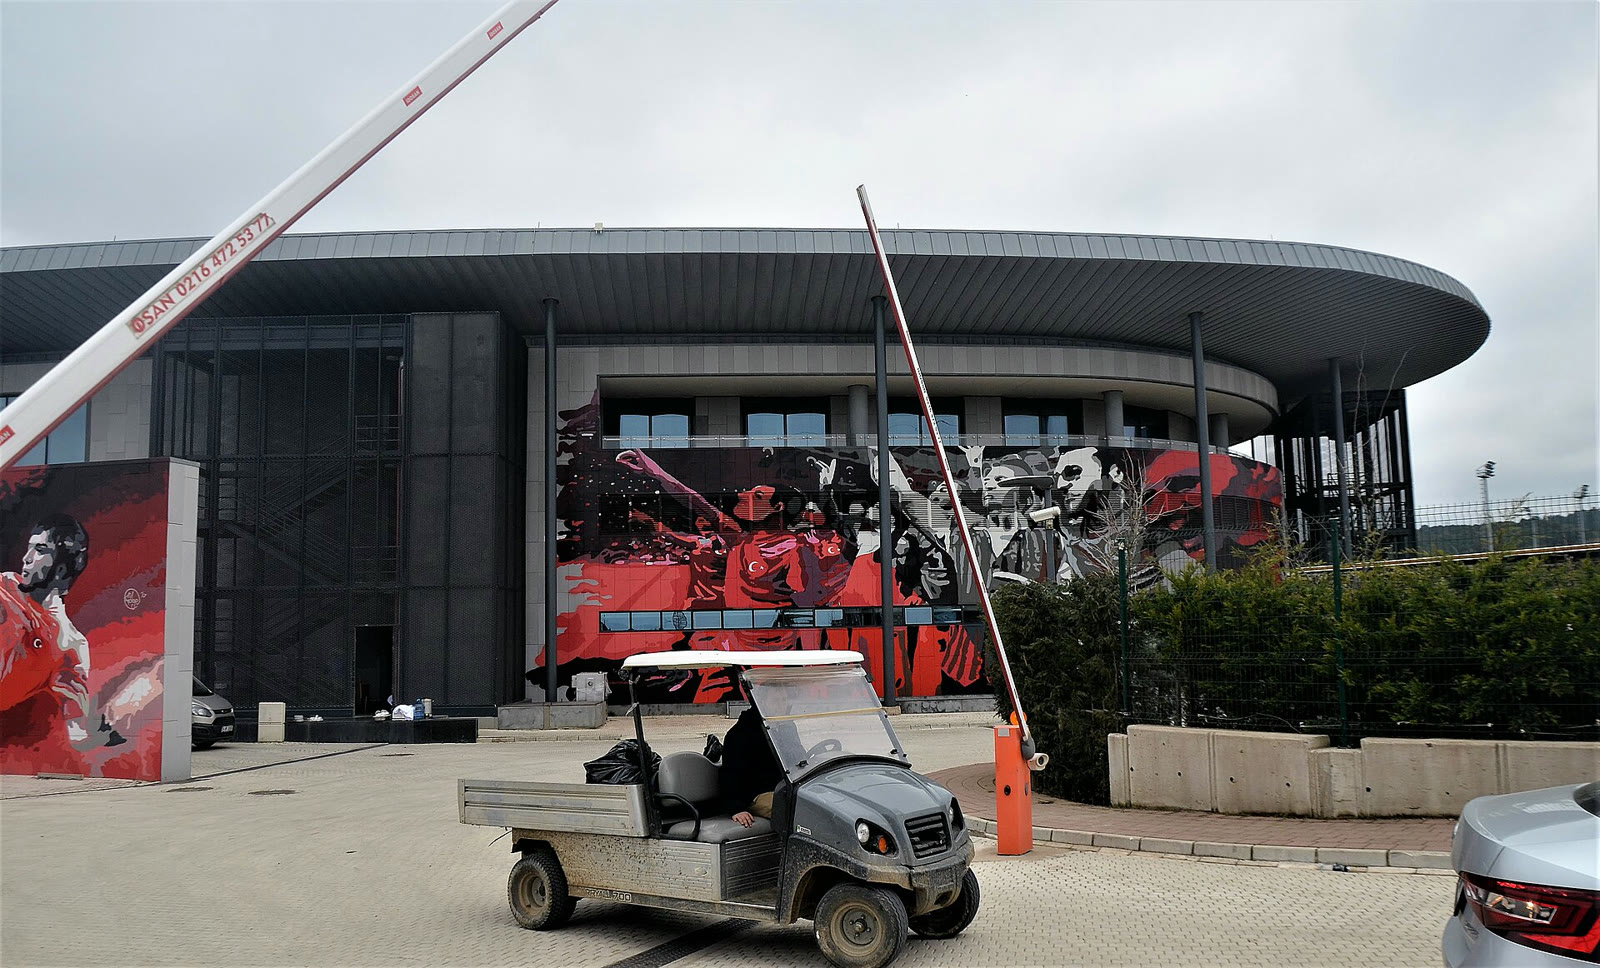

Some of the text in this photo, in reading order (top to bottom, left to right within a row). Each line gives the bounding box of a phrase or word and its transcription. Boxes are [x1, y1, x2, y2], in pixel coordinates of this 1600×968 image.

[175, 265, 210, 296] 0216
[211, 242, 237, 267] 472
[236, 227, 253, 247] 53
[254, 213, 271, 232] 77
[612, 890, 632, 903] 700
